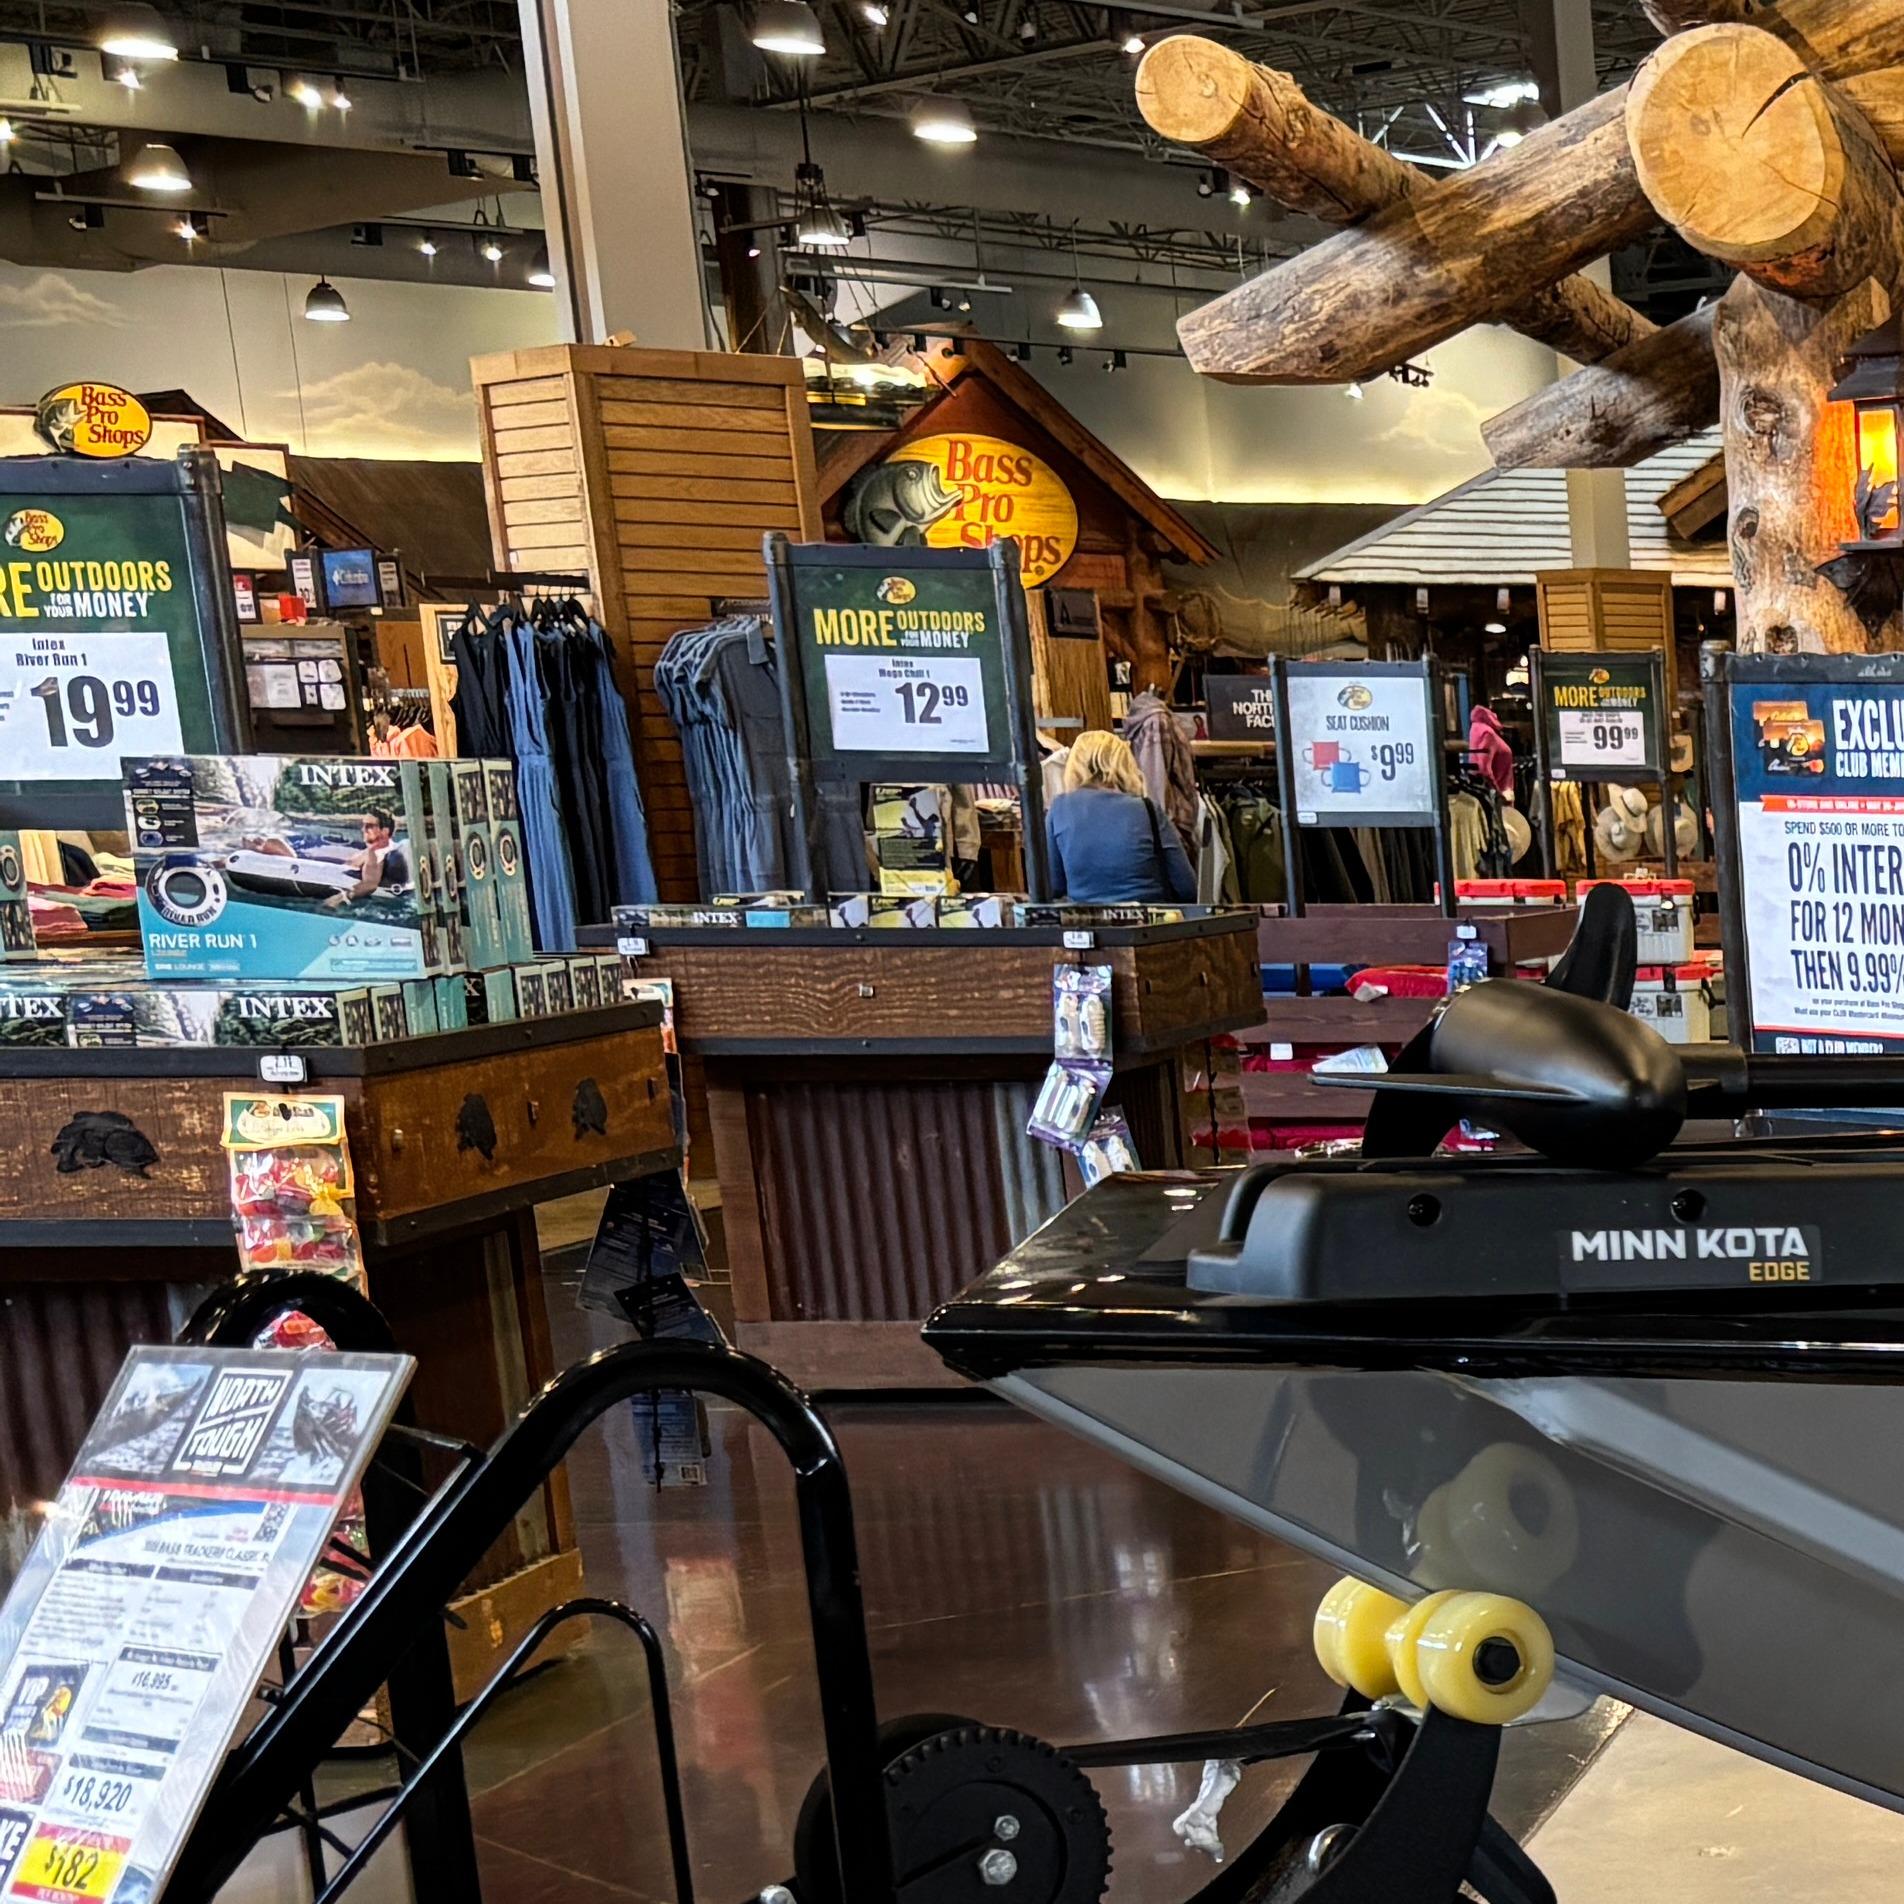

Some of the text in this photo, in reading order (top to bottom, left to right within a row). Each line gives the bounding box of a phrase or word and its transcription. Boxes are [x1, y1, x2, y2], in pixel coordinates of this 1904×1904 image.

[81, 386, 128, 407] Bass
[85, 406, 120, 425] Pro
[87, 424, 145, 448] Shops
[944, 439, 1034, 487] Bass
[951, 484, 1014, 522] Pro
[959, 521, 1062, 575] Shps
[36, 560, 173, 592] OUTDOORS
[43, 591, 149, 618] YOUR MONEY
[813, 608, 986, 647] MORE OUTDOORS
[919, 630, 970, 648] MONEY
[16, 652, 49, 667] River
[53, 653, 78, 667] Run
[895, 682, 943, 724] 12
[942, 685, 969, 707] 99
[1553, 686, 1600, 707] MORE
[1326, 715, 1390, 732] SEAT CUSHION
[1593, 725, 1624, 750] 99
[300, 763, 397, 788] INTEX
[1835, 751, 1868, 778] CLUB
[1784, 821, 1816, 835] SPEND
[1819, 822, 1843, 836] $500
[1845, 822, 1859, 836] OR
[1861, 823, 1890, 837] MORE
[1787, 841, 1826, 893] 0%
[693, 912, 740, 925] INTEX
[1102, 907, 1146, 921] INTEX
[1790, 899, 1827, 943] FOR
[1832, 901, 1855, 944] 12
[149, 933, 201, 949] RIVER
[206, 933, 244, 949] RUN
[1790, 949, 1844, 991] THEN
[0, 996, 65, 1019] TEX
[238, 996, 335, 1019] INTEX
[1569, 1225, 1810, 1263] MINN KOTA
[1748, 1261, 1811, 1283] EDGE
[206, 1377, 282, 1419] NORTH
[187, 1416, 263, 1459] TOUGH
[63, 1774, 133, 1813] $18,920
[44, 1845, 99, 1890] $182
